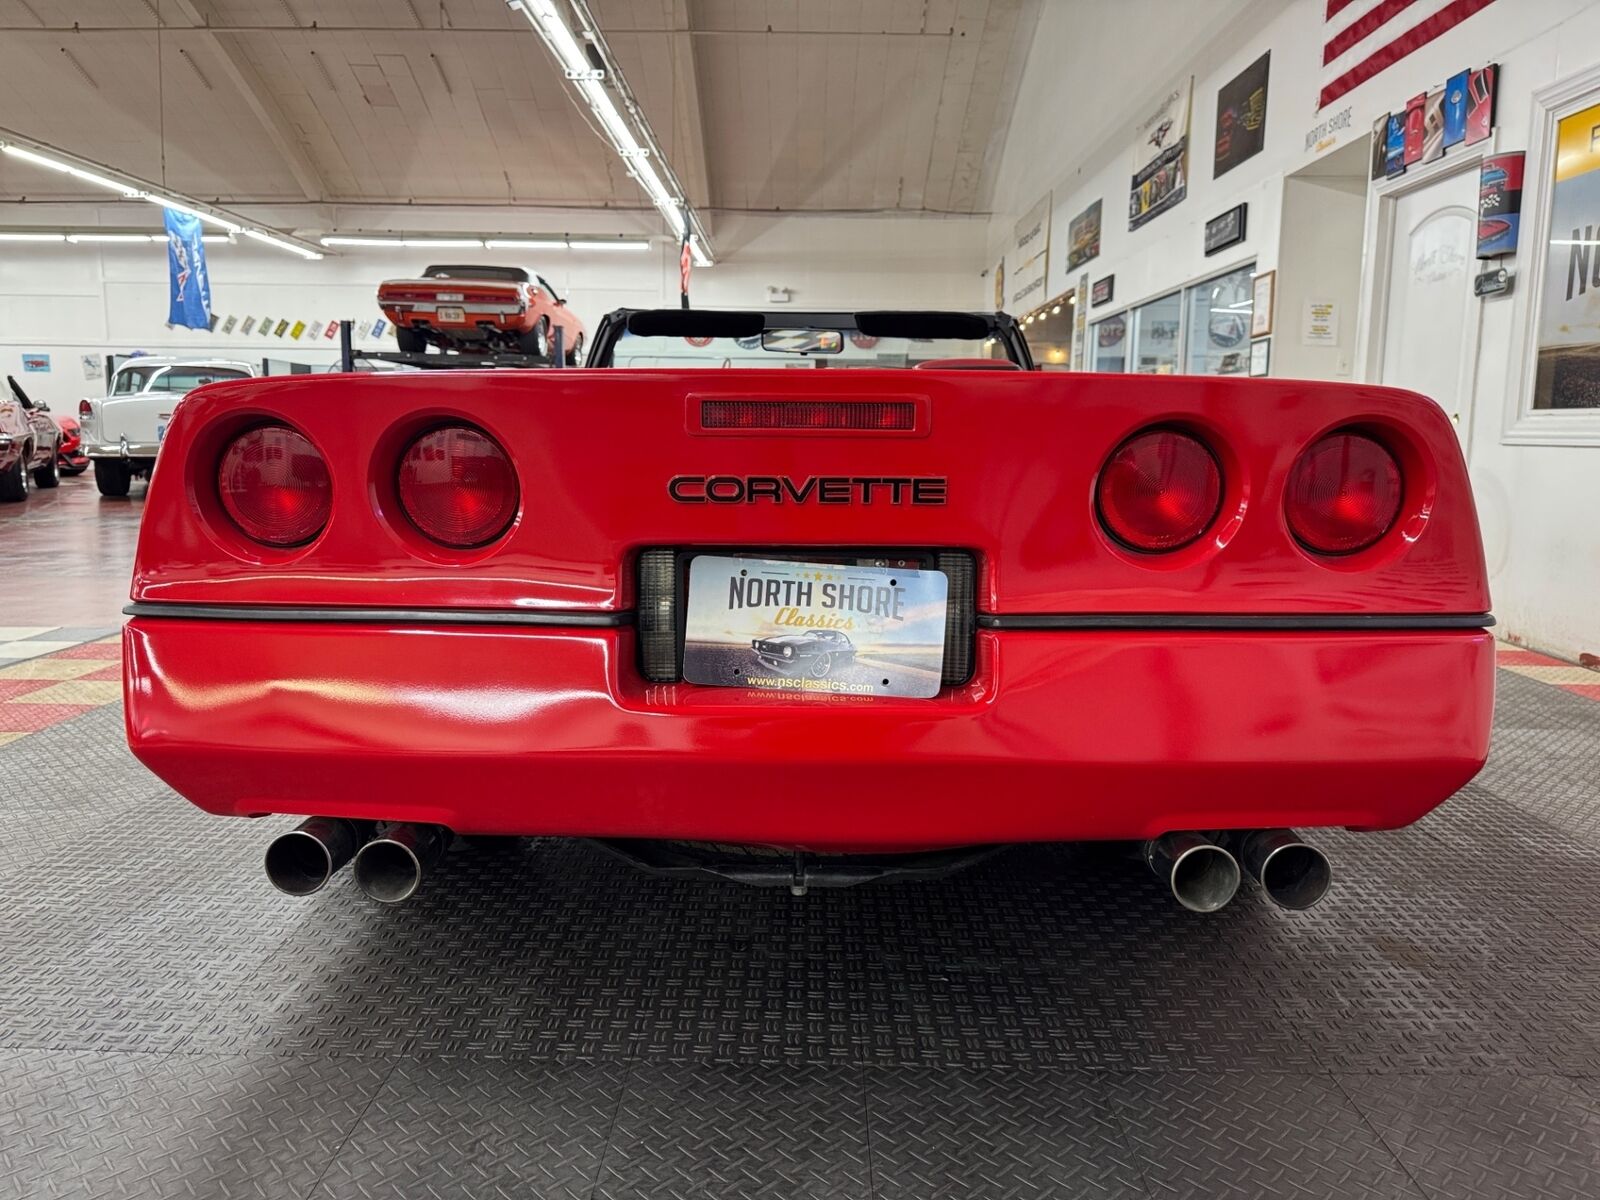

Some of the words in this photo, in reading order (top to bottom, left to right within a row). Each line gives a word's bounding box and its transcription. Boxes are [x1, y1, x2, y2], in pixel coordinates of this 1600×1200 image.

[667, 474, 947, 505] CORVETTE
[728, 576, 812, 610] NORTH
[821, 582, 906, 621] SHORE
[774, 606, 854, 630] Classics
[747, 676, 874, 692] www.nsclassics.com
